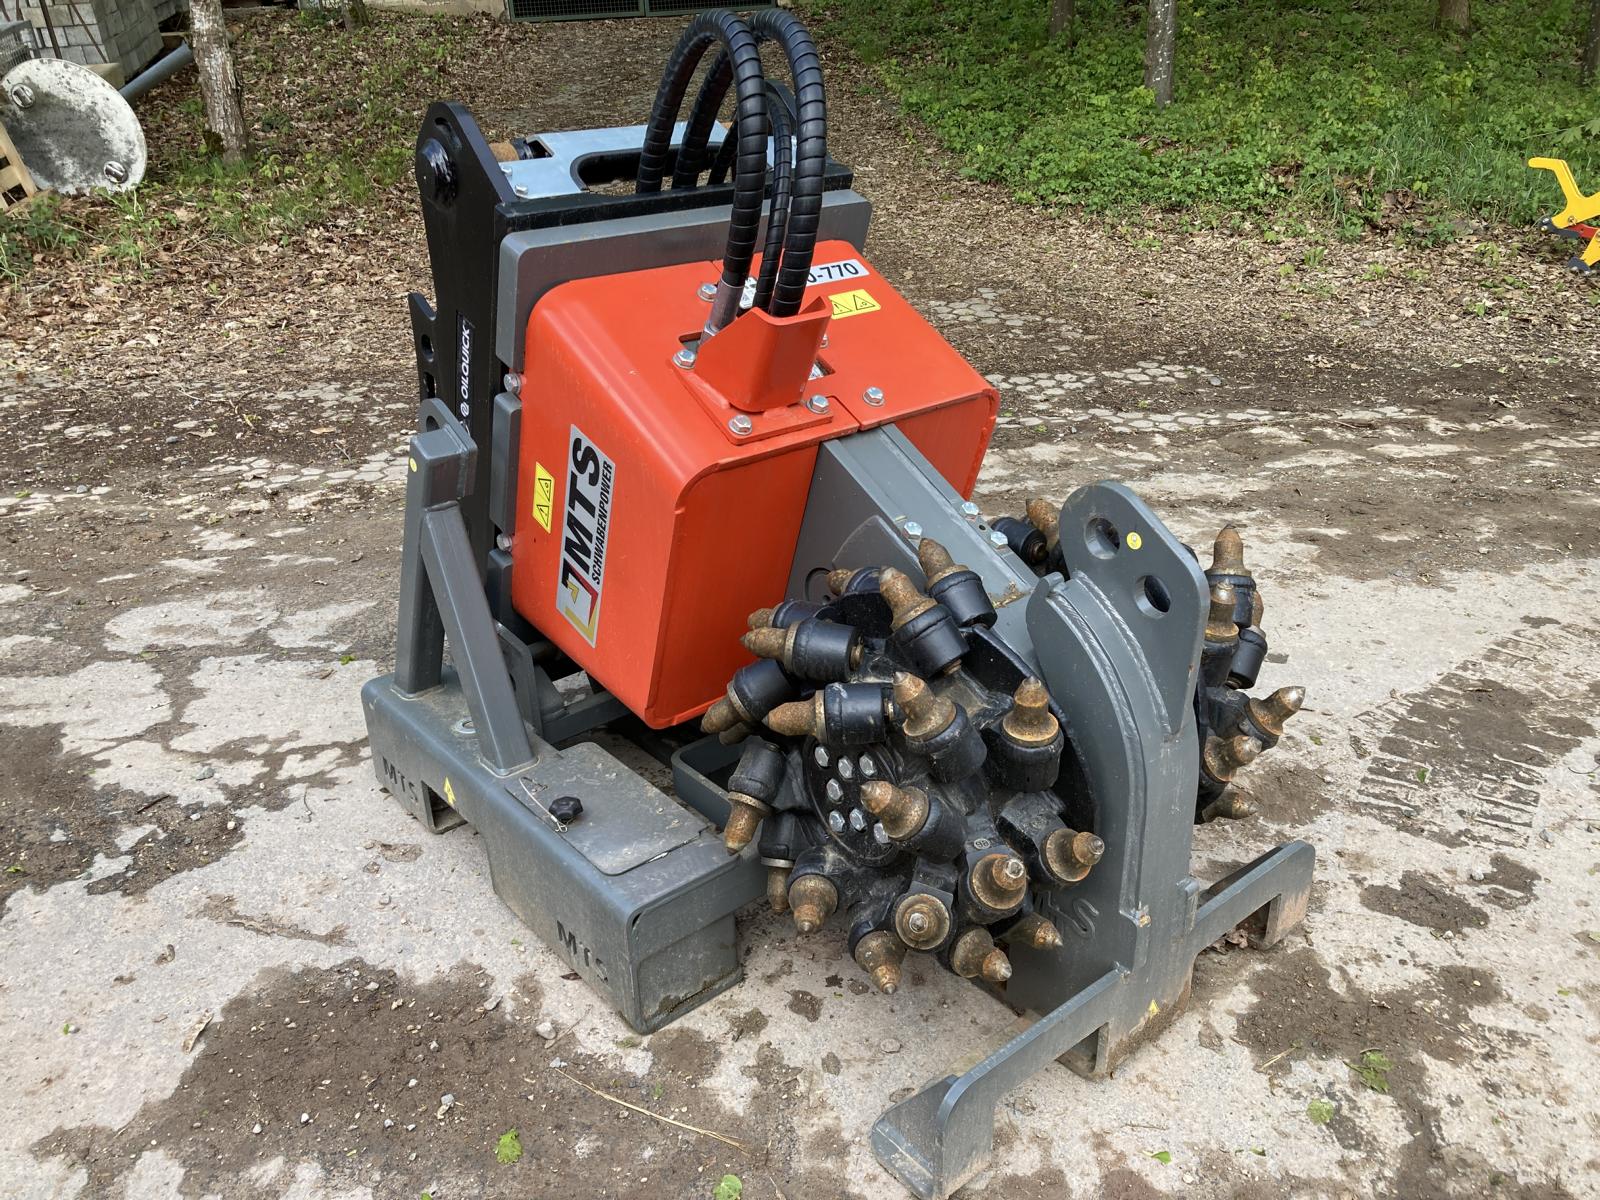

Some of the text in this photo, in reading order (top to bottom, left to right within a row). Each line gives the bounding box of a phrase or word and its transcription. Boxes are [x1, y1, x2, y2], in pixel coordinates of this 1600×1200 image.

[461, 324, 470, 399] OILQUICK
[564, 437, 600, 575] MTS
[592, 460, 613, 585] SCHWABENPOWER
[382, 756, 418, 803] MTS
[556, 920, 609, 984] MTS
